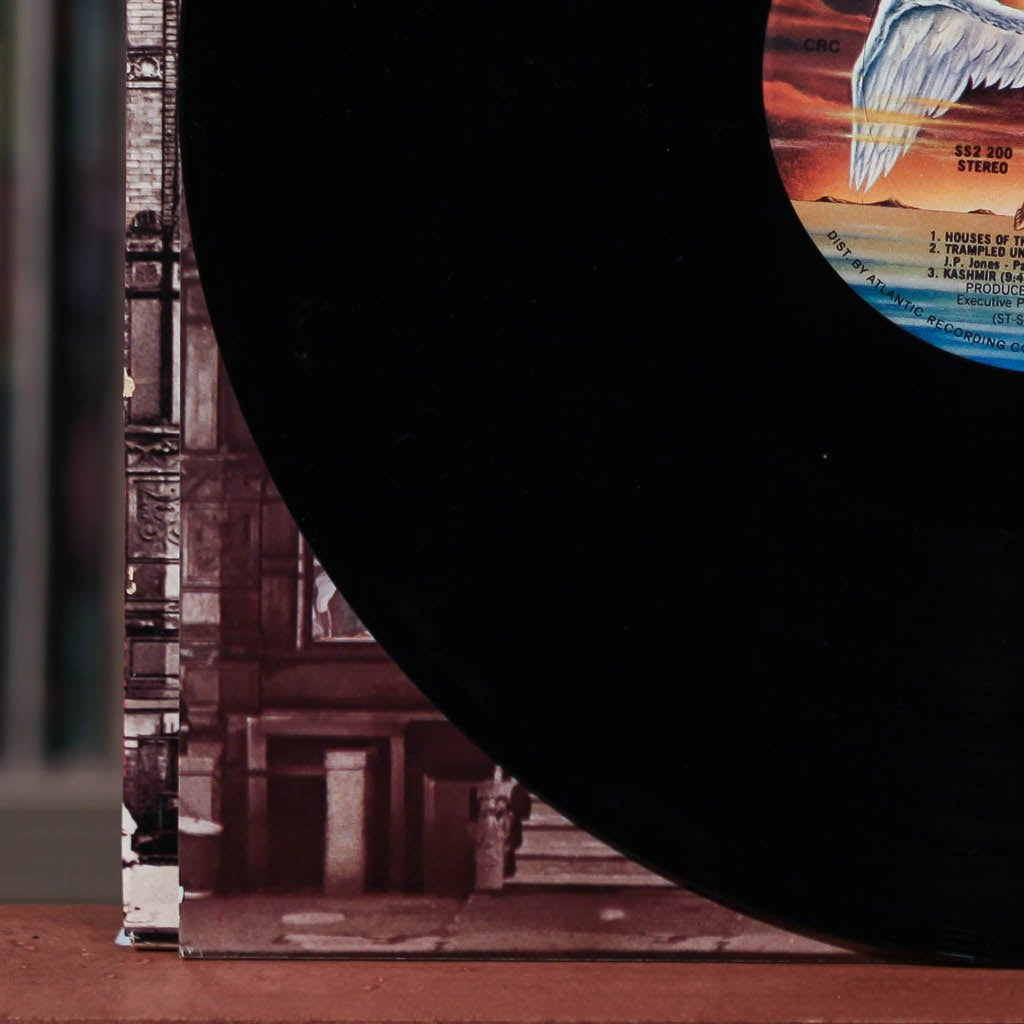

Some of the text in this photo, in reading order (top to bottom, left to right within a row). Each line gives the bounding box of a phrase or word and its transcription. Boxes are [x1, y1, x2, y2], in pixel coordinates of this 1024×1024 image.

[804, 38, 841, 53] CRC
[955, 144, 1013, 159] SS2 200
[957, 159, 1009, 174] STEREO
[945, 232, 992, 244] HOUSES
[995, 234, 1010, 245] OF
[945, 244, 1006, 257] TRAMPLED
[968, 258, 1000, 270] Jones
[943, 268, 996, 282] KASHMIR
[851, 259, 869, 274] BY
[866, 275, 924, 317] ATLANTIC
[927, 315, 1006, 350] RECORDING
[957, 295, 1012, 308] Executive
